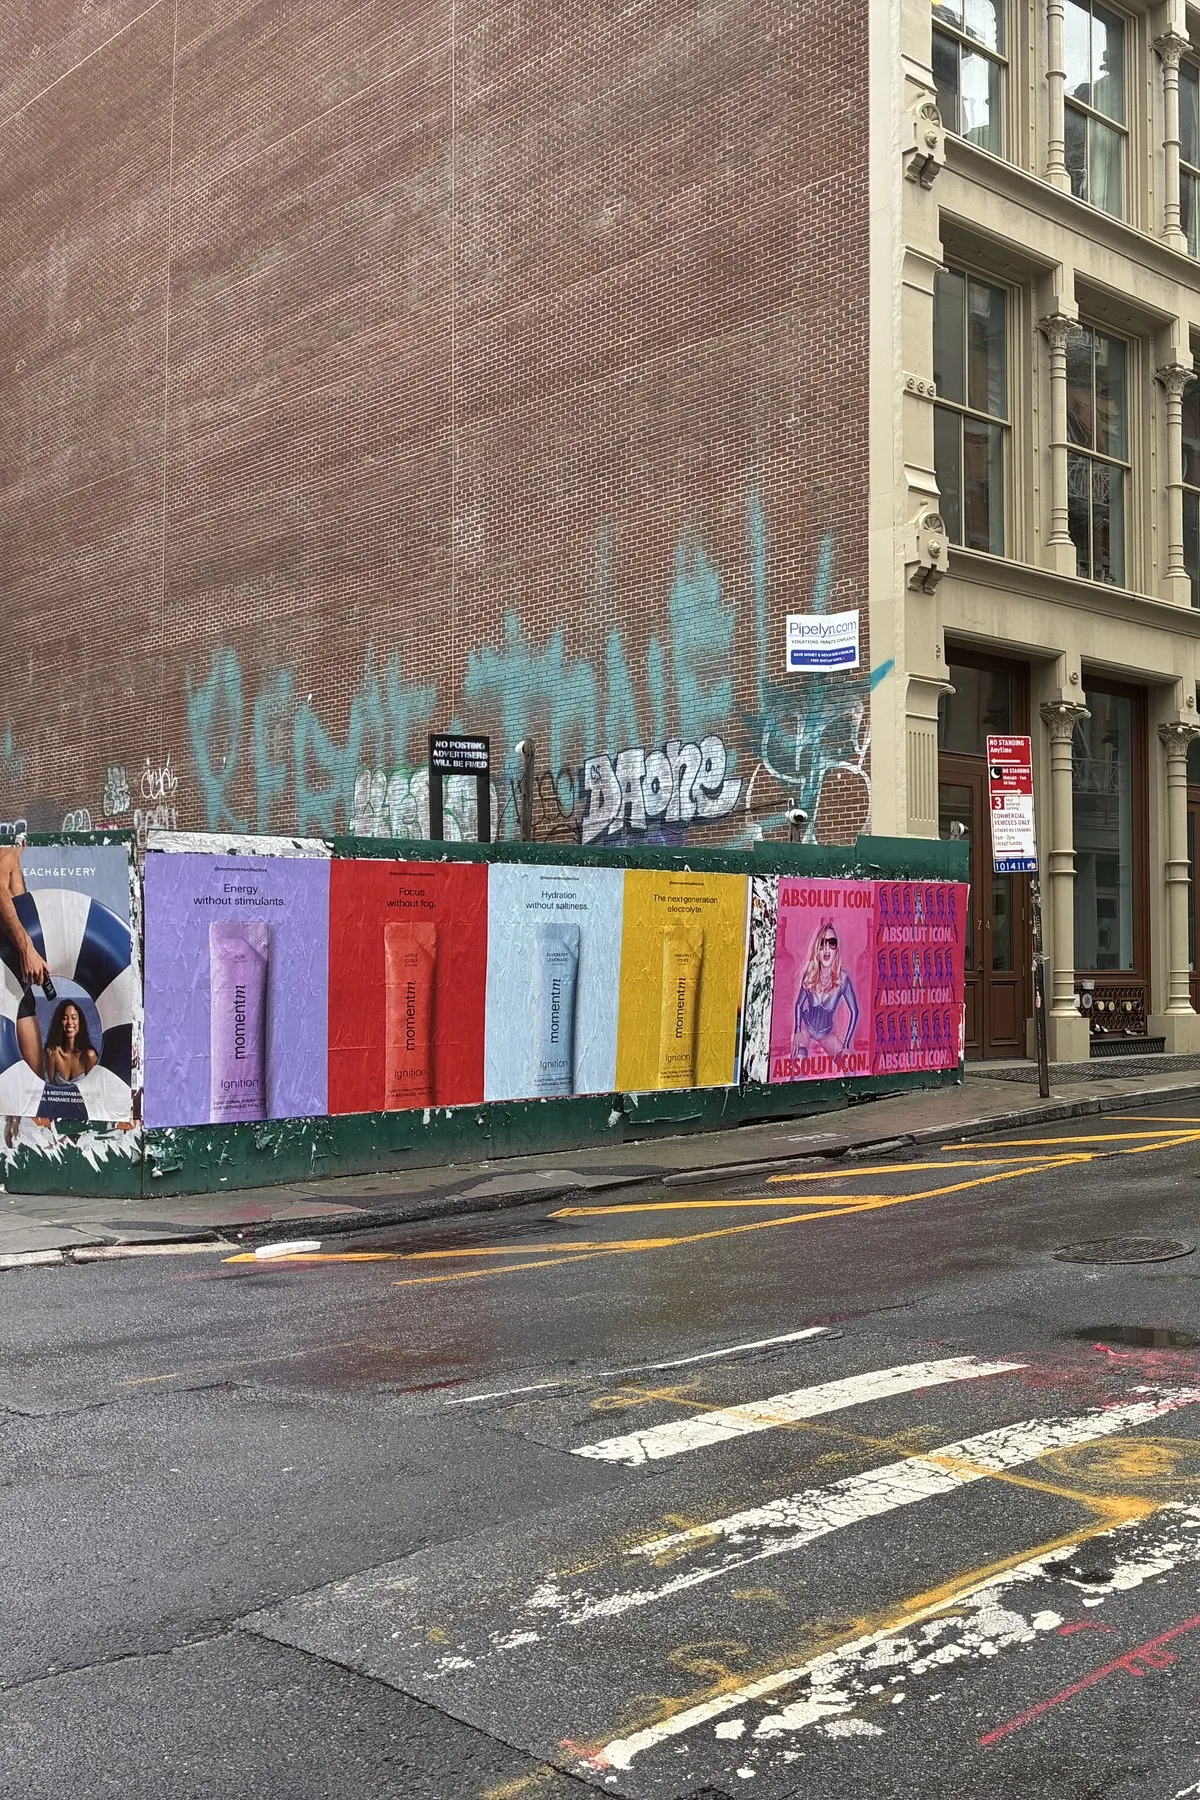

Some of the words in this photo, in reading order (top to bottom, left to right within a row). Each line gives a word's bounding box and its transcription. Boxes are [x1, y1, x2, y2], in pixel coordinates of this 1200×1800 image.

[789, 620, 857, 638] Pipelyn.com
[435, 740, 448, 748] NO
[450, 741, 486, 750] POSTING
[433, 750, 488, 760] ADVERTISERS
[433, 758, 452, 766] WILL
[464, 760, 488, 768] FINED
[994, 797, 1002, 809] 3
[996, 862, 1025, 870] 101411
[23, 867, 96, 877] EACH&EVERY
[224, 884, 258, 895] Energy
[399, 887, 425, 896] Focus
[193, 896, 231, 905] without
[234, 896, 286, 906] stimulants.
[542, 891, 577, 900] Hydration
[654, 894, 666, 902] The
[781, 888, 841, 908] ABSOLUT
[843, 890, 874, 908] ICON.
[386, 899, 418, 907] without
[420, 900, 436, 909] fog.
[526, 901, 554, 909] without
[556, 902, 589, 910] saltiness.
[667, 905, 703, 914] electrolyte.
[882, 926, 927, 942] ABSOLUT
[929, 927, 954, 942] ICON.
[880, 988, 925, 1006] ABSOLUT
[927, 988, 952, 1004] ICON.
[551, 978, 561, 1043] momentm
[676, 977, 686, 1038] momentm
[405, 980, 416, 1051] momentm
[233, 984, 246, 1060] momentm
[666, 1053, 691, 1063] Ignition
[878, 1050, 924, 1070] ABSOLUT
[925, 1050, 950, 1067] ICON.
[540, 1059, 568, 1070] Ignition
[773, 1056, 835, 1078] ABSOLUT
[836, 1053, 870, 1073] ICON.
[394, 1068, 427, 1080] Ignition
[221, 1078, 259, 1091] Ignition
